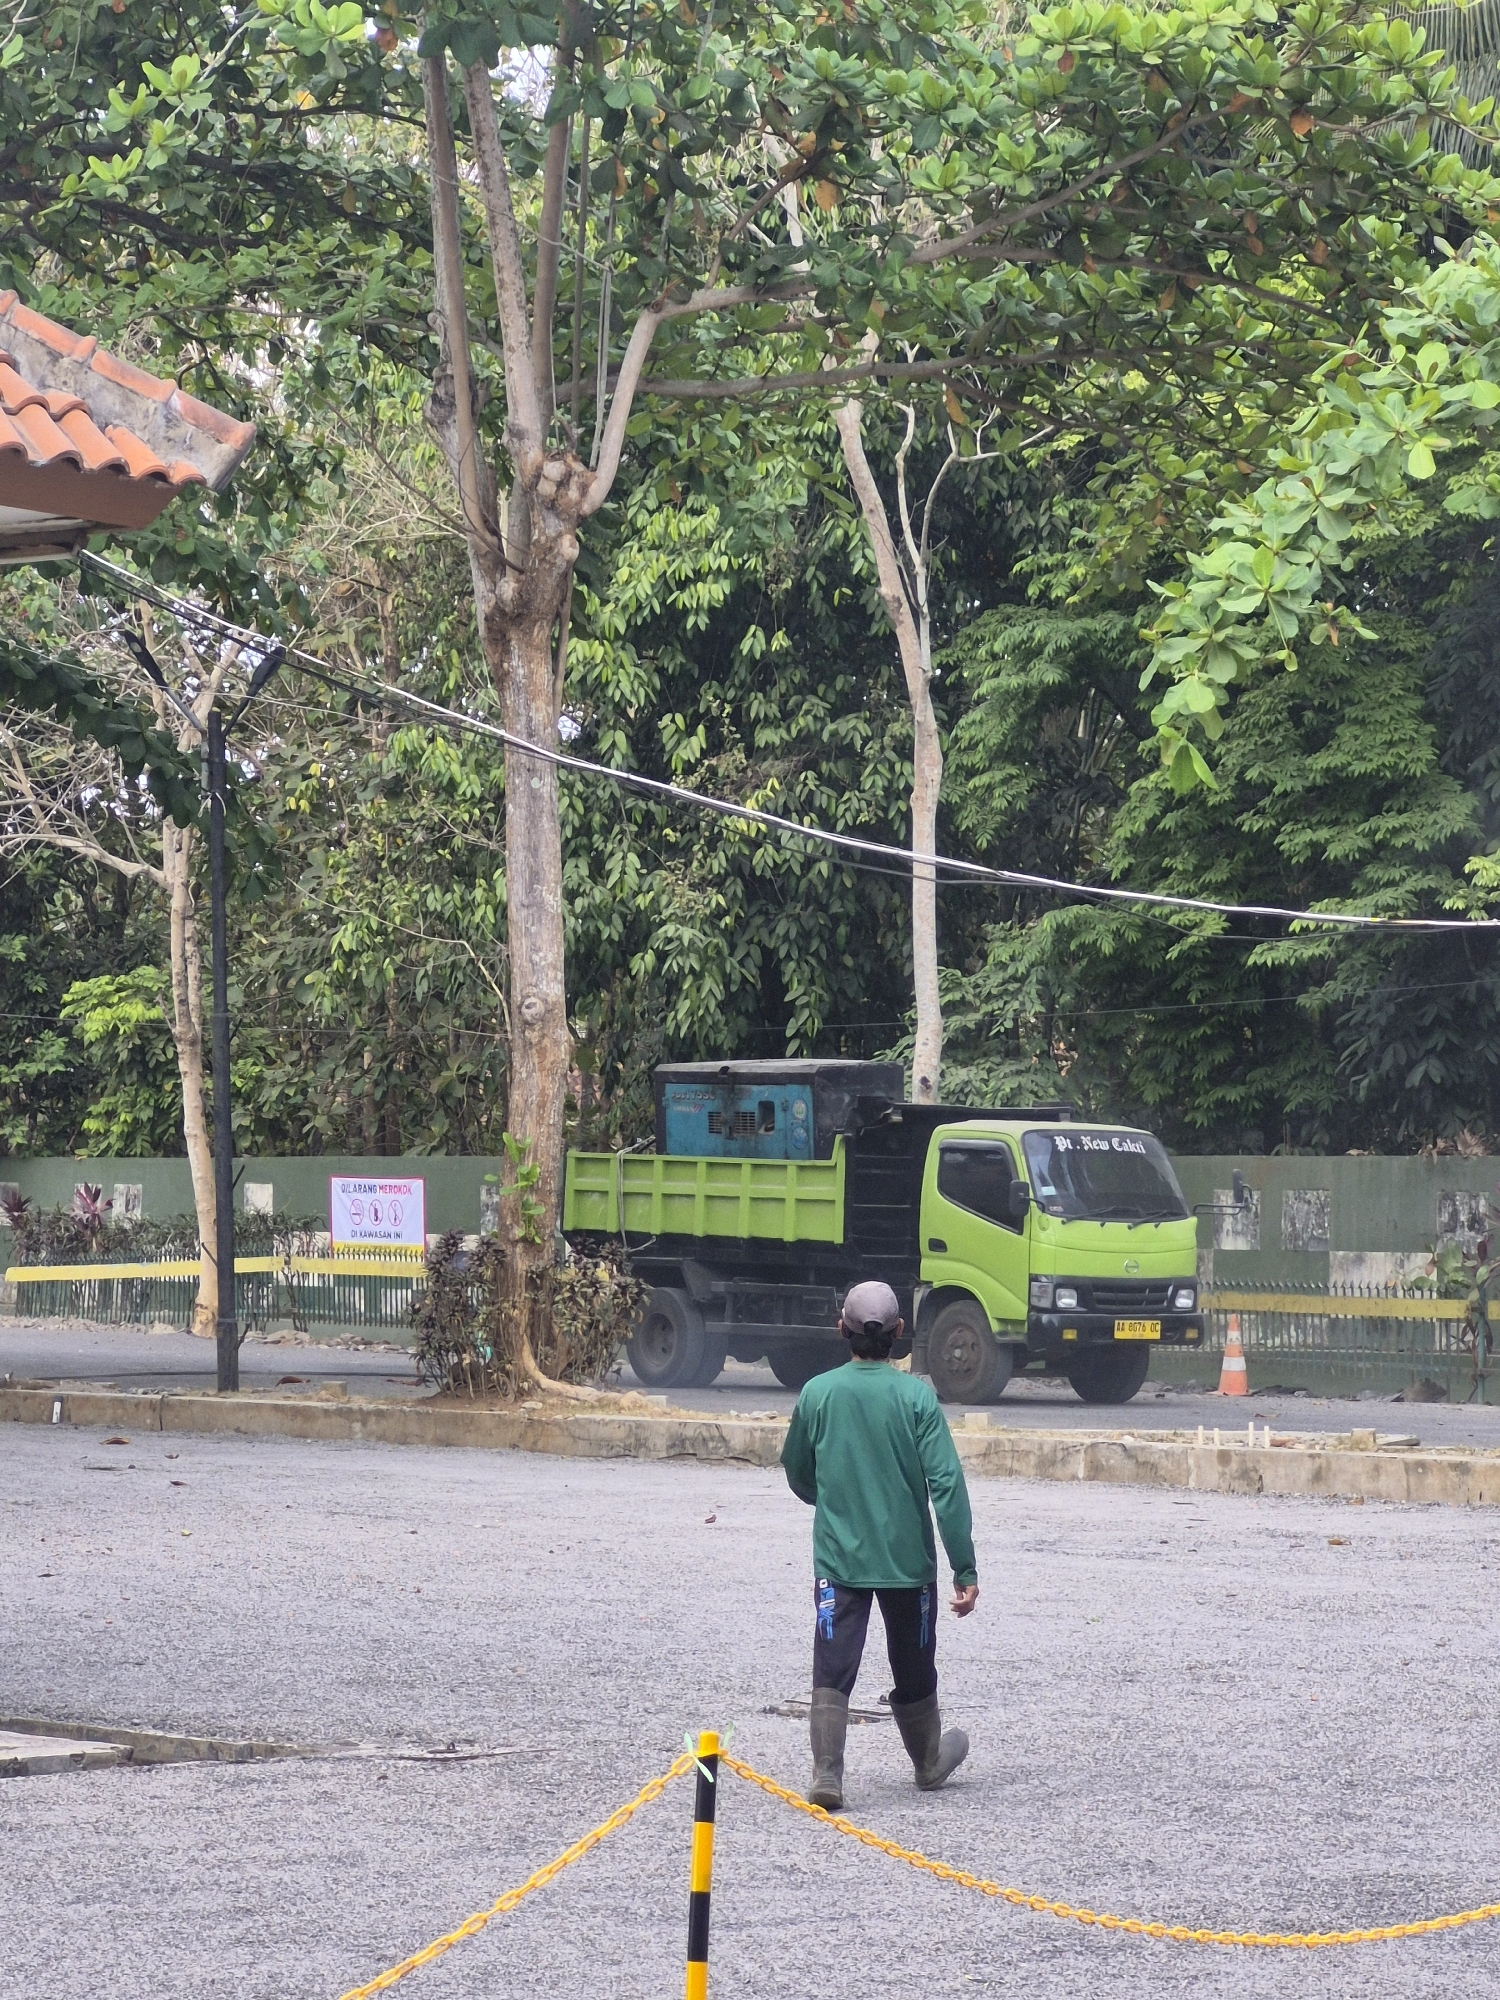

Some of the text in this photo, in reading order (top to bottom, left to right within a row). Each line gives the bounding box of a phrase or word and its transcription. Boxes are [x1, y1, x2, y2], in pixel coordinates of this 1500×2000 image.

[1081, 1136, 1109, 1151] New
[341, 1183, 412, 1195] DILARANG MEROKOK
[351, 1230, 358, 1238] DI
[360, 1230, 392, 1239] KAWASAN
[1117, 1322, 1125, 1332] AA
